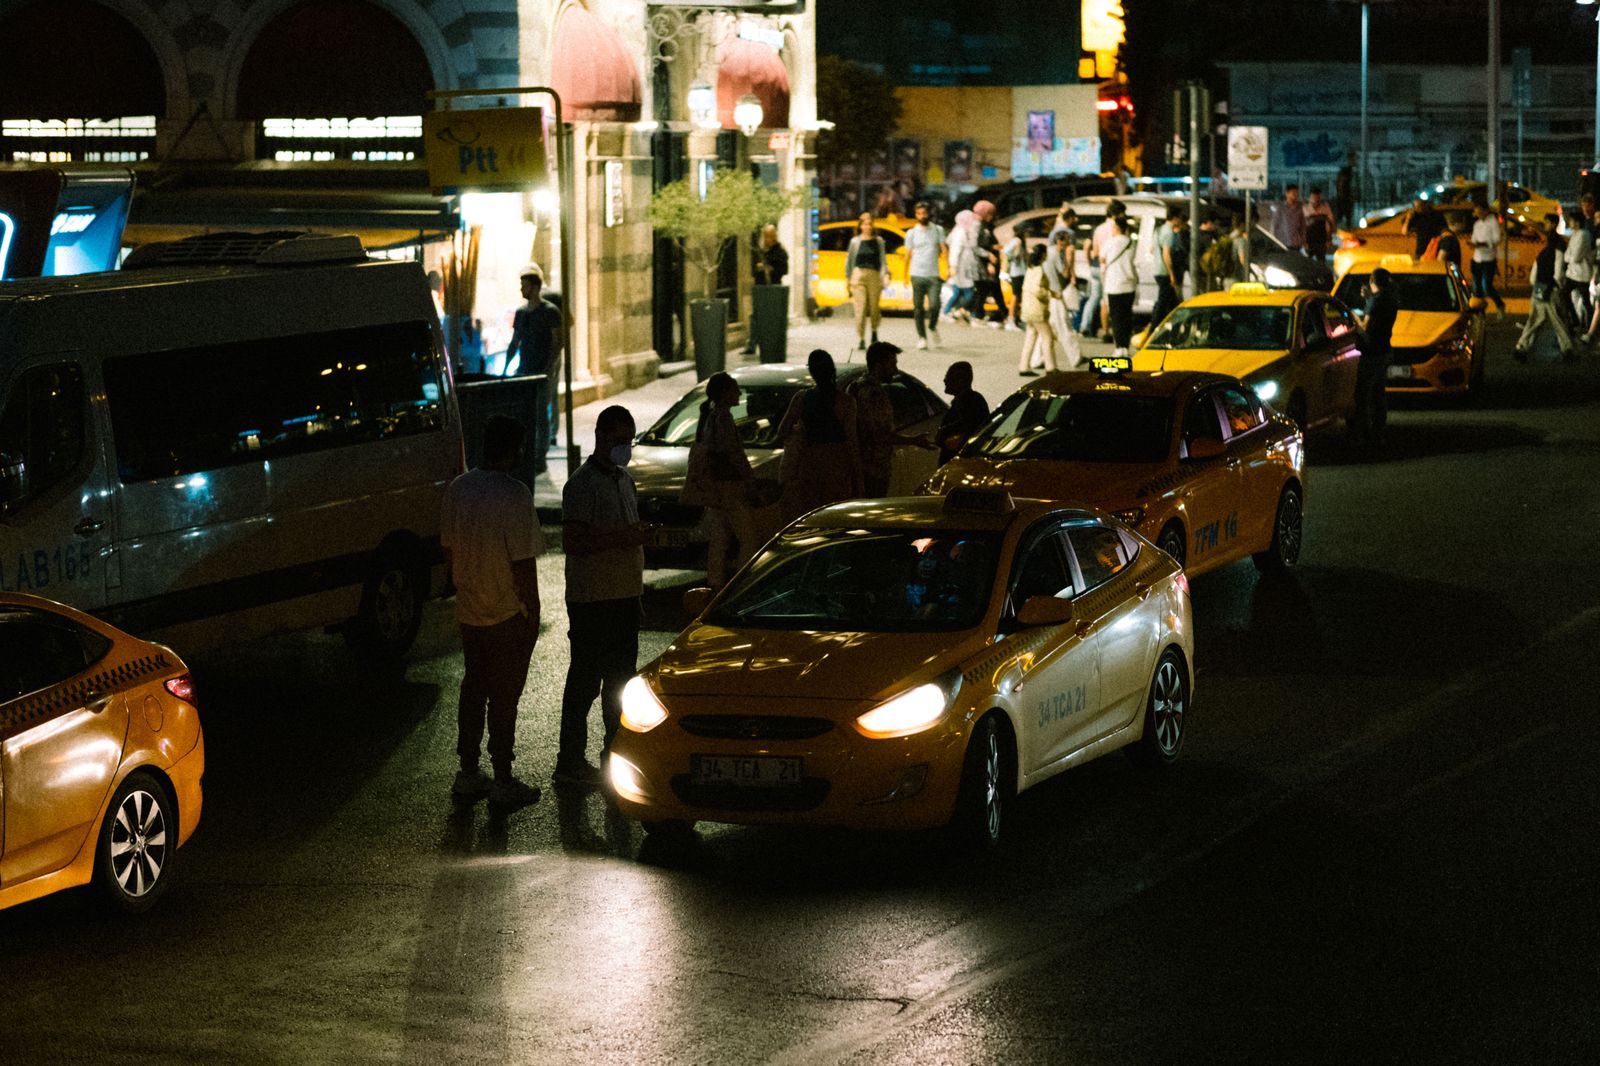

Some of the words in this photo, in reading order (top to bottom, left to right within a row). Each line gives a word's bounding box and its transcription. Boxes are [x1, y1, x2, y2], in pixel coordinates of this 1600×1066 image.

[702, 759, 722, 778] 34
[732, 759, 761, 779] TCA
[779, 760, 797, 779] 21
